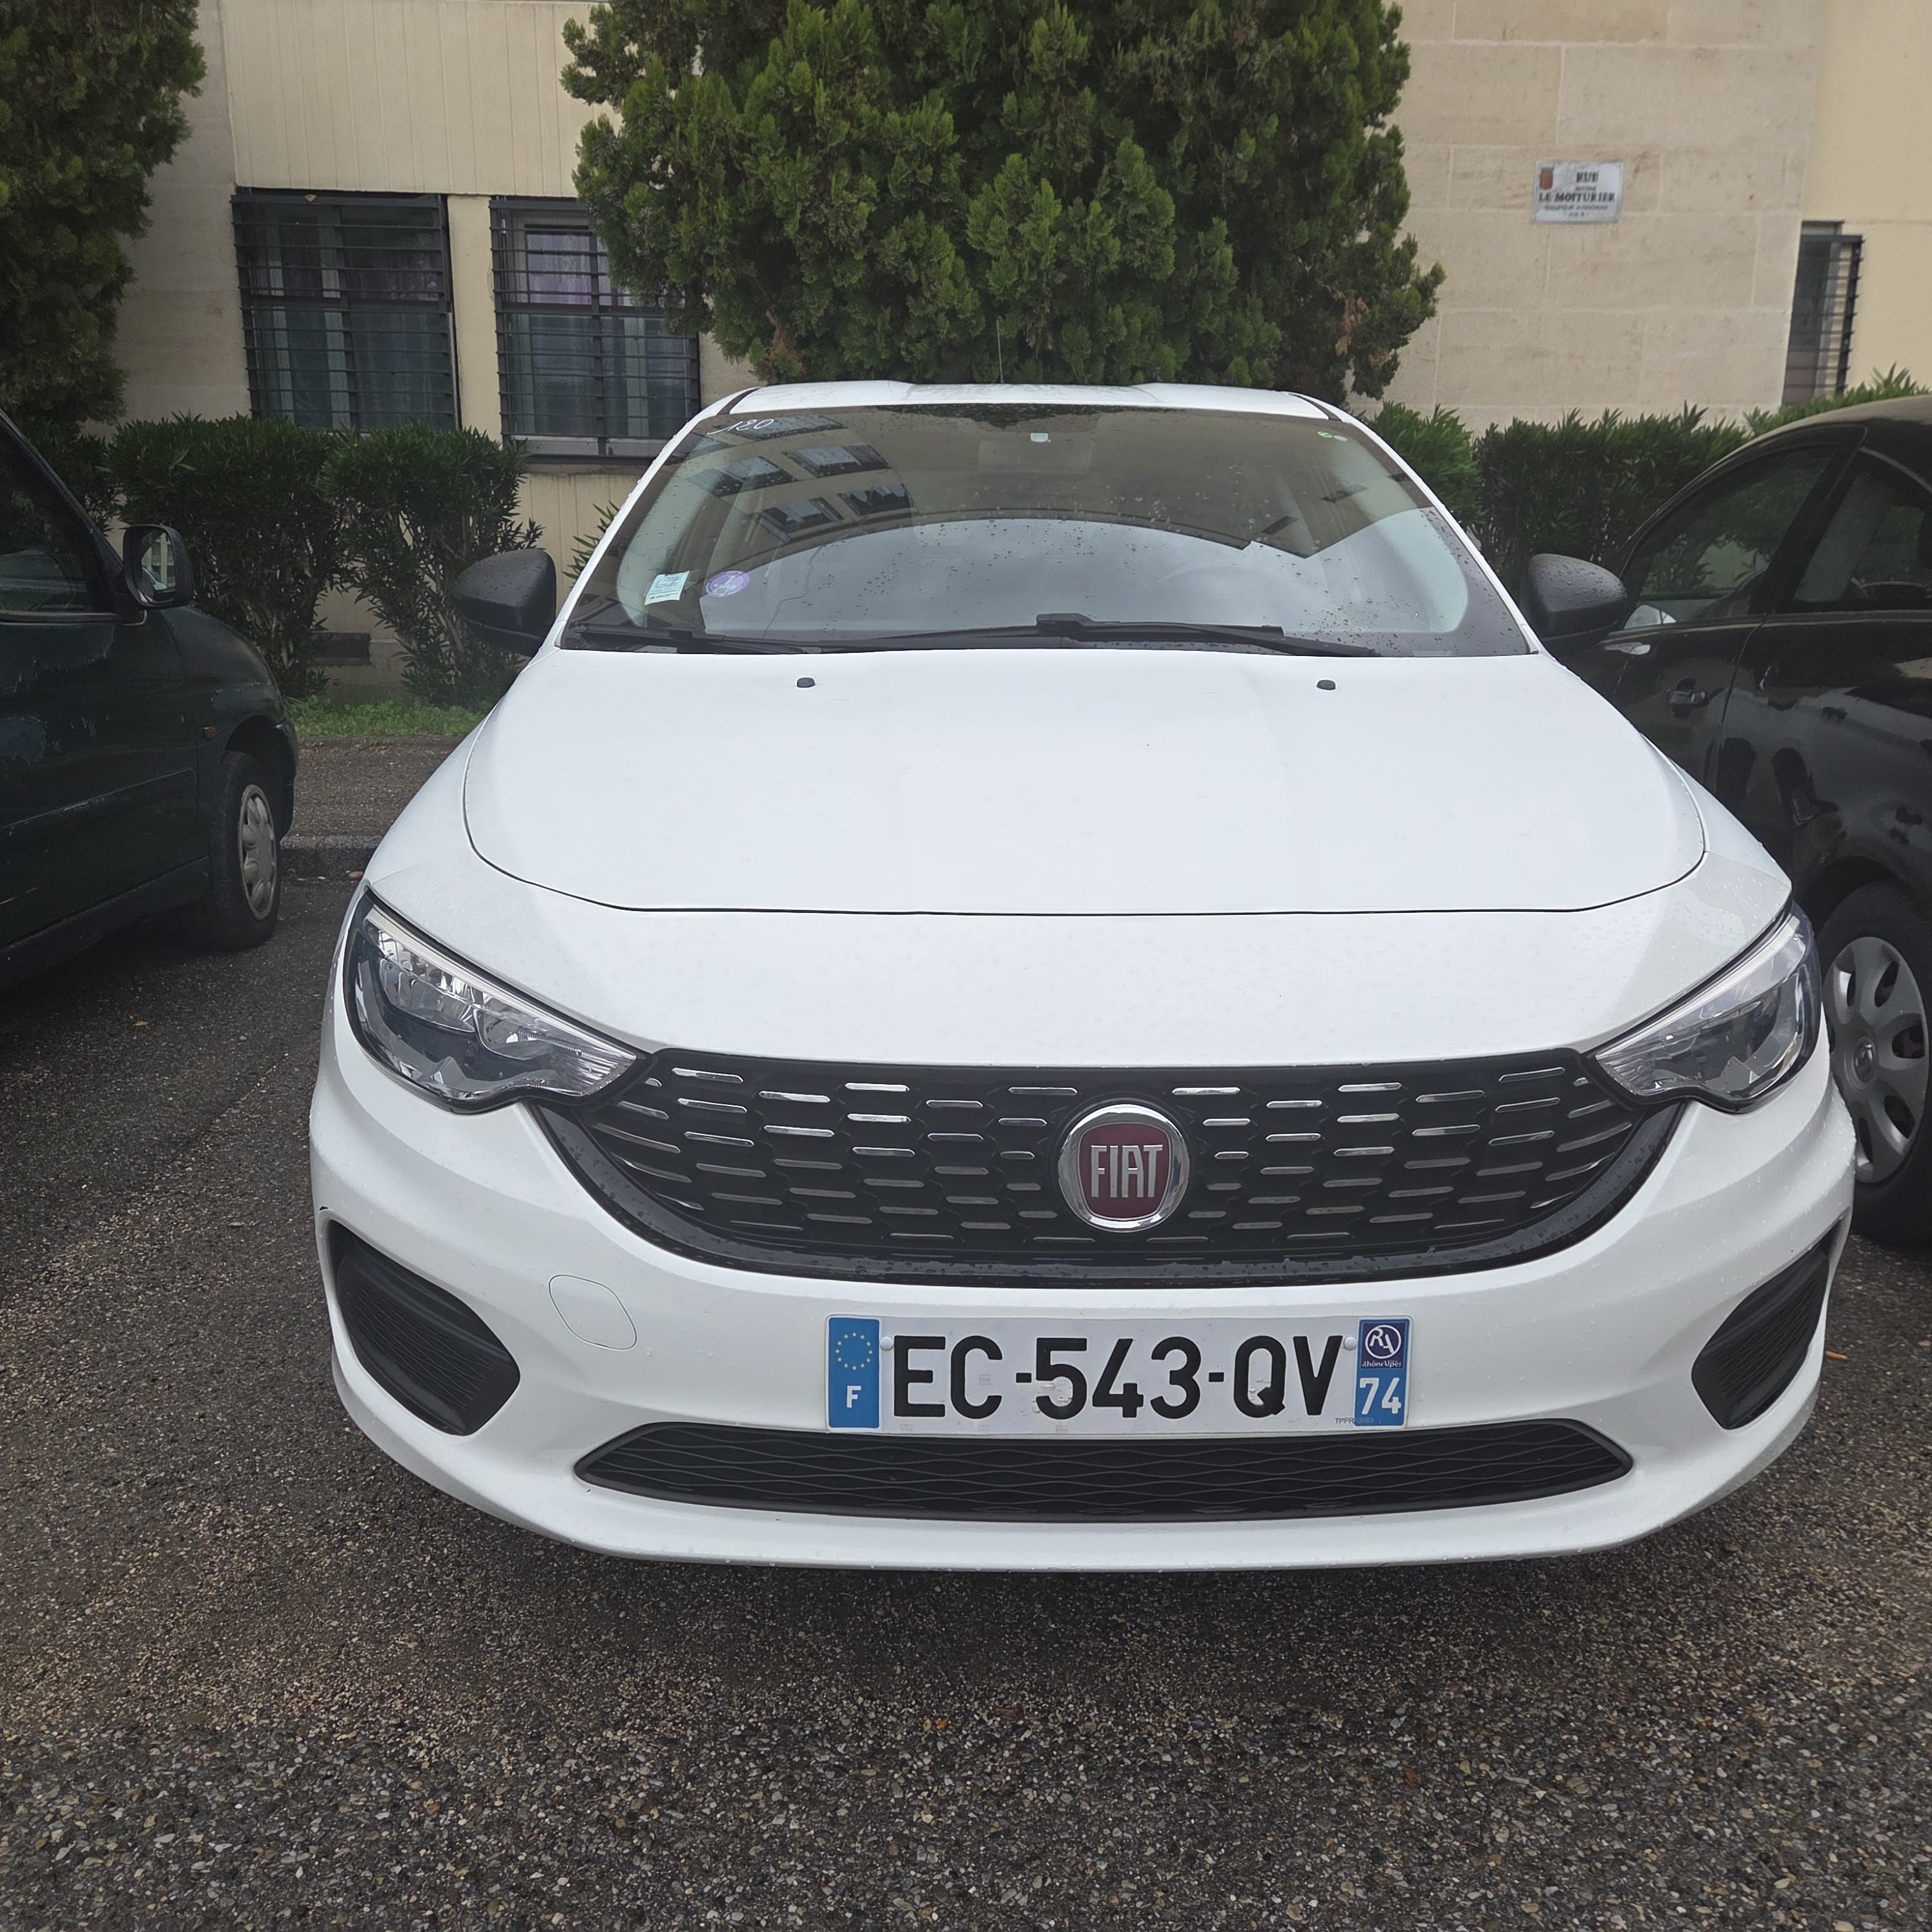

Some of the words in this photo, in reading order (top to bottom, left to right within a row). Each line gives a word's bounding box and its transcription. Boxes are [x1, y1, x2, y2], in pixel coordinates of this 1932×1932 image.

[1576, 172, 1599, 183] RUE
[1539, 192, 1551, 202] LE
[1554, 192, 1615, 203] MOITURIER
[1091, 1144, 1164, 1198] FIAT
[893, 1335, 1344, 1420] EC-543-QV
[846, 1385, 862, 1409] F
[1359, 1377, 1402, 1415] 74
